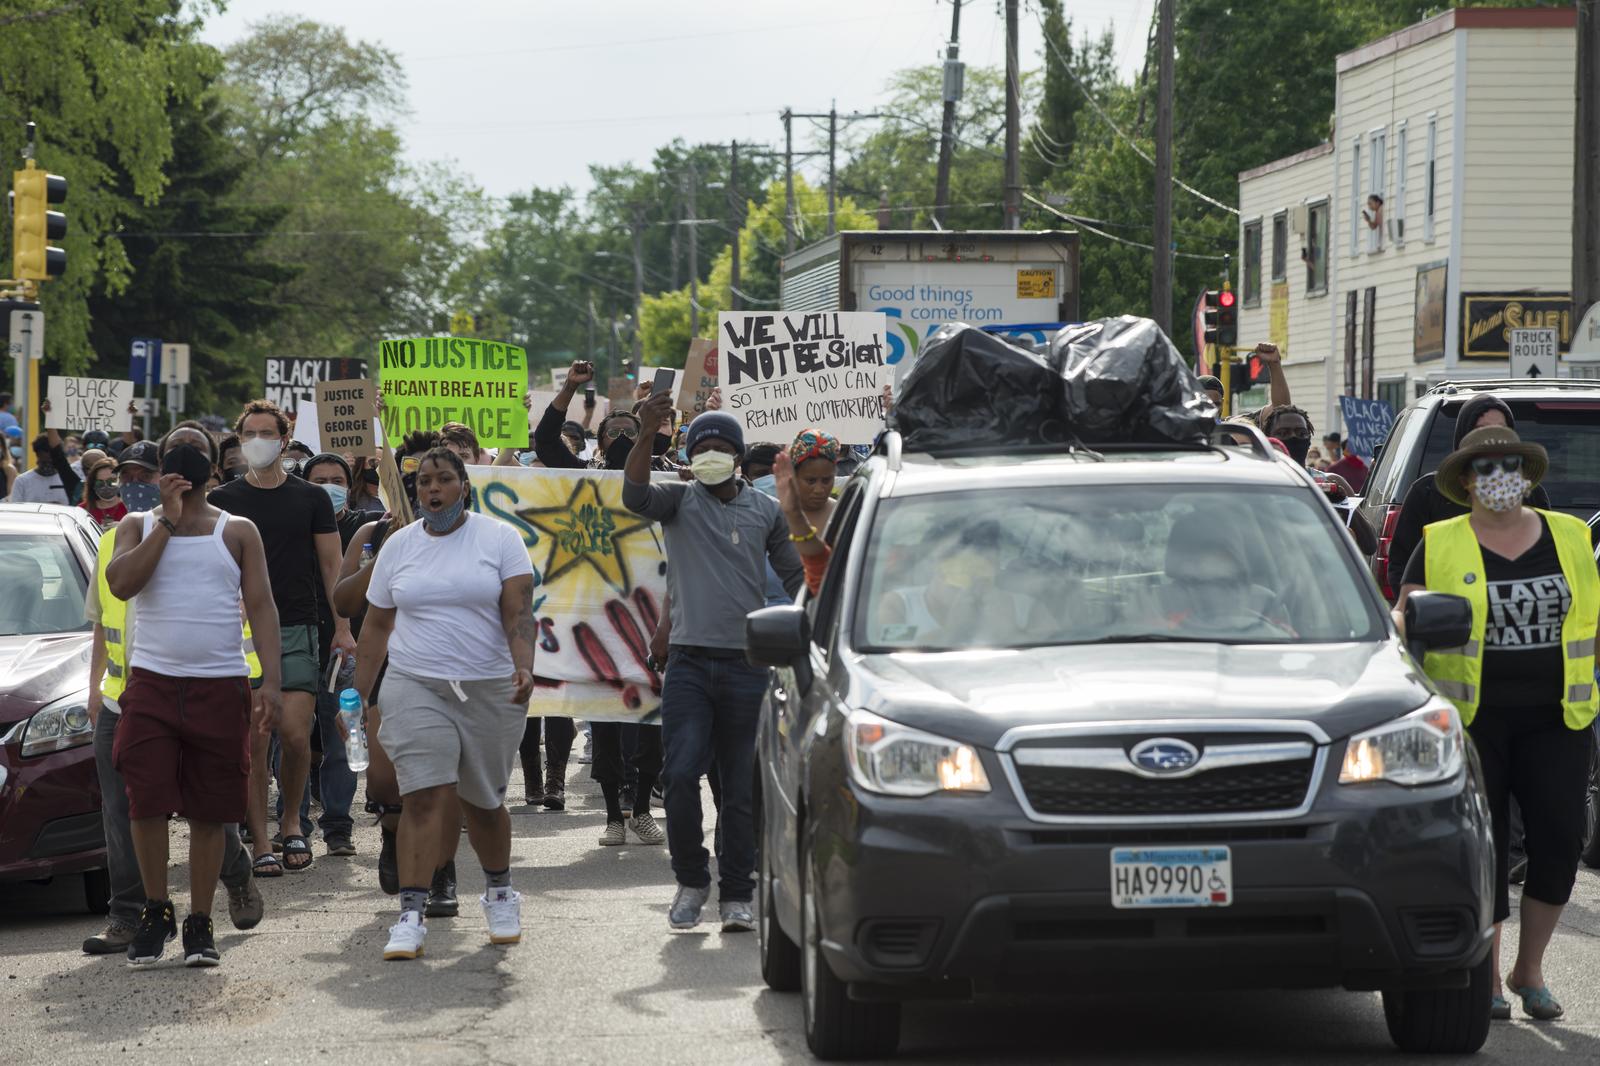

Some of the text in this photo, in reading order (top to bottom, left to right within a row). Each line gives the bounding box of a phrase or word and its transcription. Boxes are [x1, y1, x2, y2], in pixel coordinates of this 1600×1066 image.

[868, 285, 973, 306] Good things
[910, 303, 1003, 321] come from
[723, 315, 776, 349] WE
[782, 312, 845, 342] WILL
[1514, 331, 1553, 343] TRUCK
[382, 338, 522, 371] NO JUSTICE
[1514, 344, 1553, 356] ROUTE
[266, 359, 322, 387] BLACK
[727, 342, 790, 385] NOT
[793, 342, 825, 374] BE
[65, 378, 119, 398] BLACK
[324, 389, 364, 402] JUSTICE
[730, 393, 752, 408] SO
[759, 380, 799, 400] THAT
[804, 375, 838, 393] YOU
[845, 371, 876, 389] CAN
[66, 399, 116, 418] LIVES
[334, 405, 355, 416] FOR
[746, 394, 886, 429] REMAIN COMFORTABLE
[1345, 397, 1392, 426] BLACK
[65, 416, 113, 432] MATTER
[325, 420, 368, 433] GEORGE
[426, 406, 511, 439] PEACE
[1356, 421, 1390, 438] LIVES
[331, 436, 363, 448] FLOYD
[1487, 577, 1570, 605] LACK
[1115, 865, 1204, 896] HA9990
